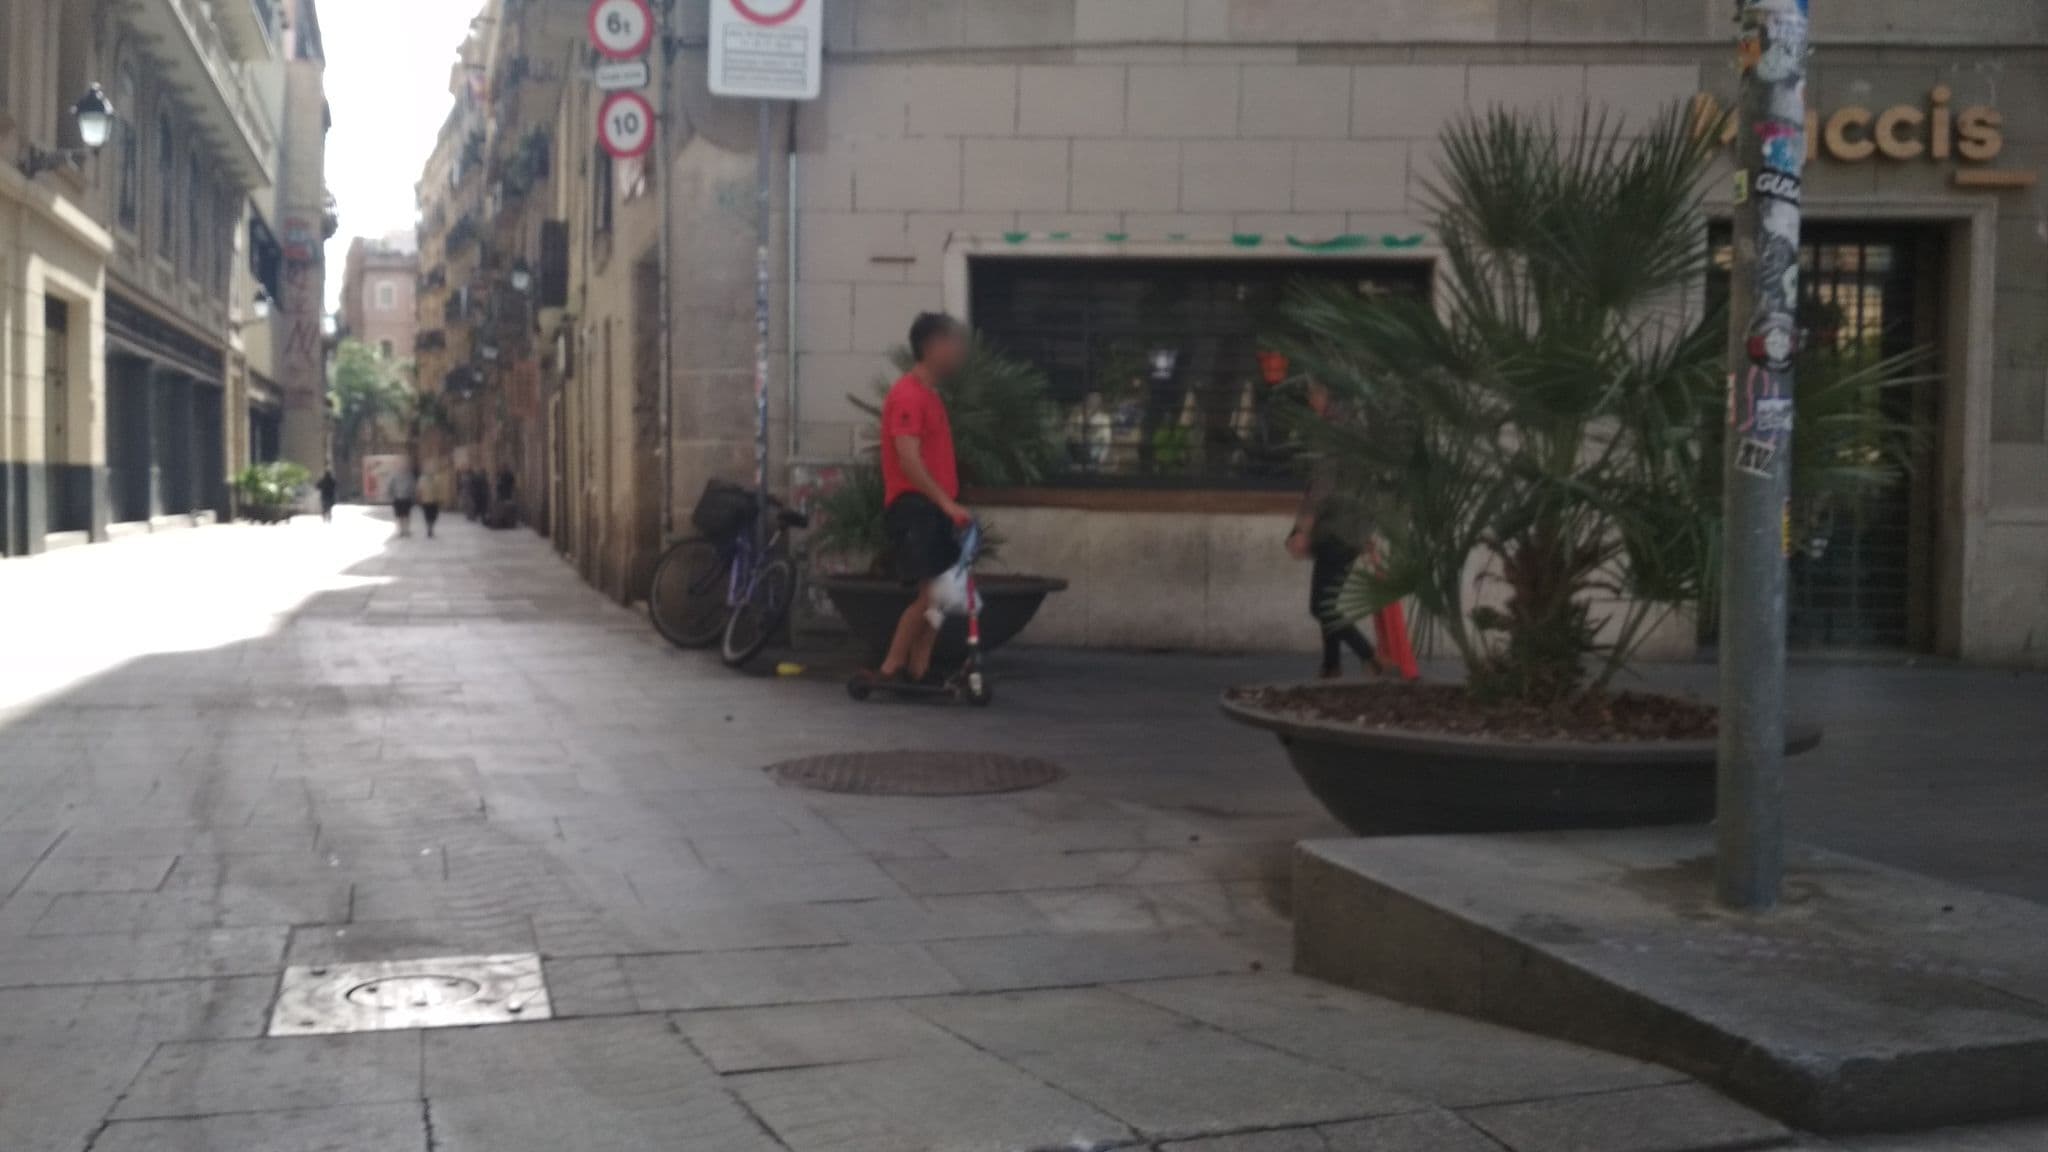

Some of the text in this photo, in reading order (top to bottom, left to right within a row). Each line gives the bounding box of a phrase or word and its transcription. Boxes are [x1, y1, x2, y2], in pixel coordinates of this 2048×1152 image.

[606, 11, 631, 34] 6t
[613, 111, 640, 137] 10
[1692, 84, 2004, 161] ccis
